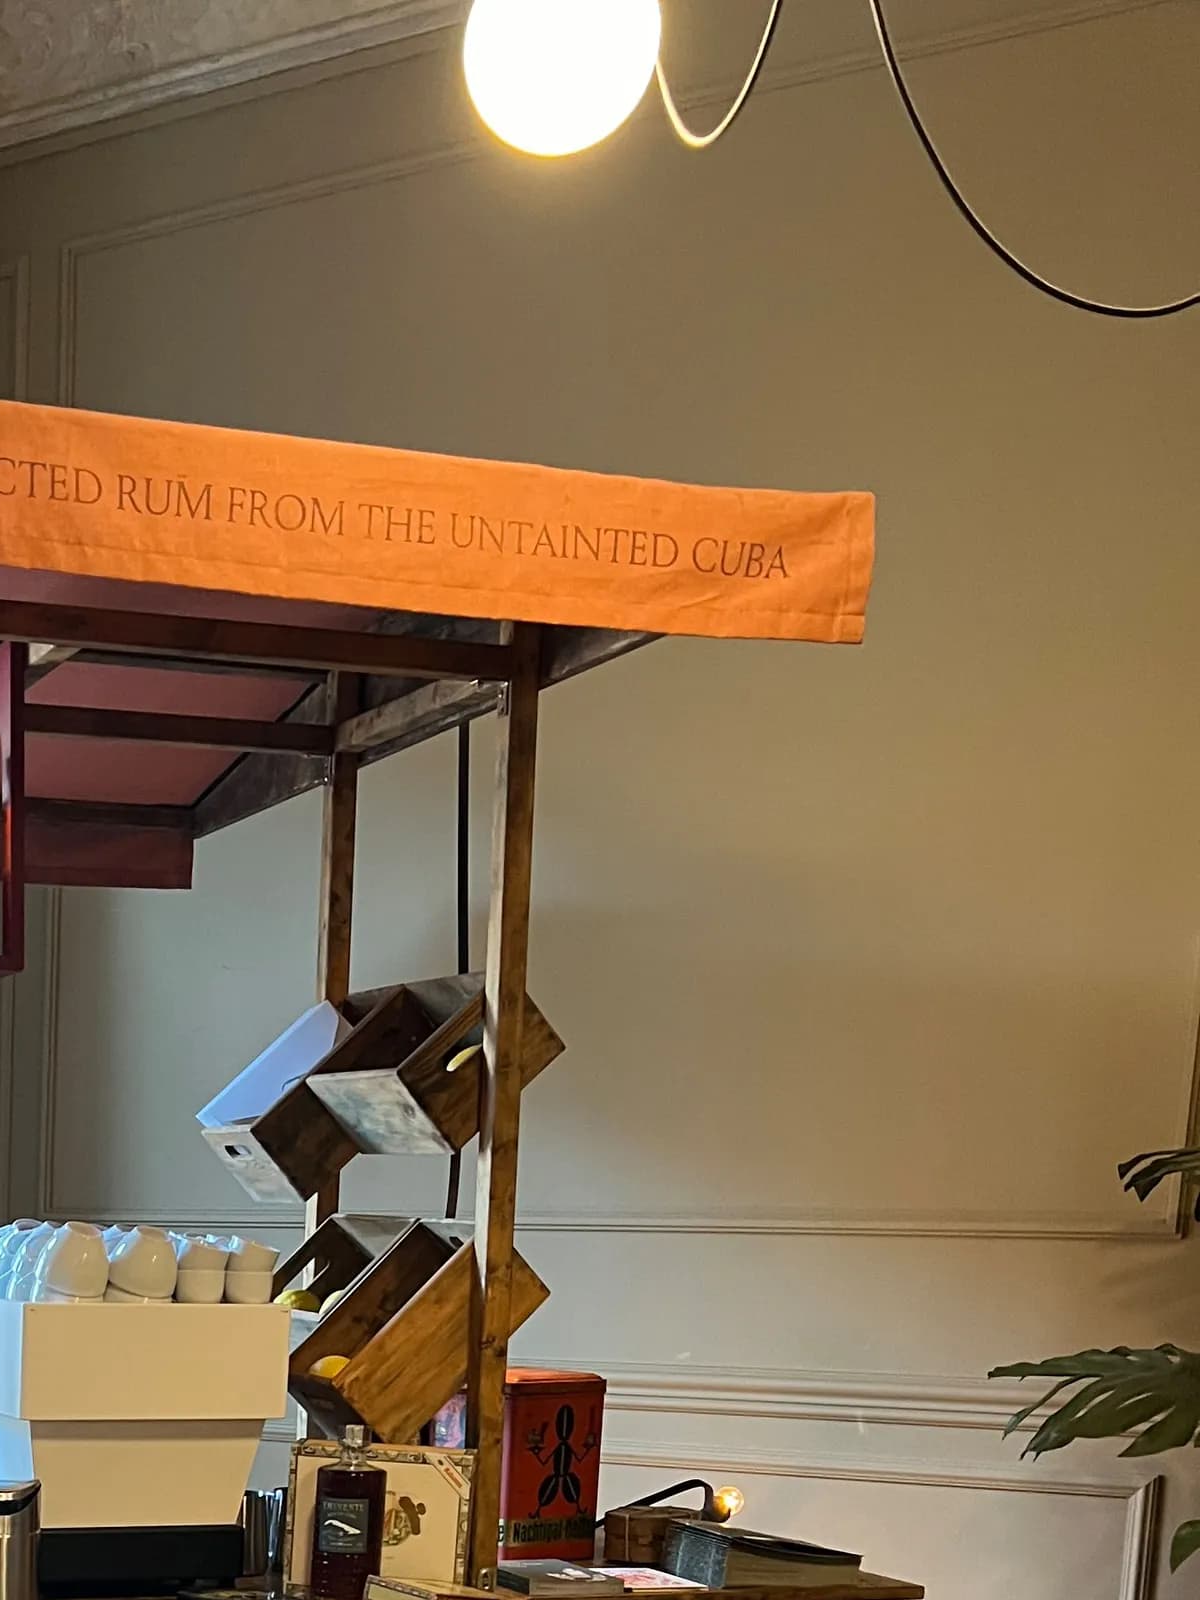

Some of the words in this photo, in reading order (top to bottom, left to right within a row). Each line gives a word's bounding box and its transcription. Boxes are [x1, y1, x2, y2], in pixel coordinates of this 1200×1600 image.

[116, 473, 214, 522] RUM
[227, 485, 346, 538] FROM
[357, 503, 436, 547] THE
[450, 511, 680, 569] UNTAINTED
[692, 535, 791, 580] CUBA
